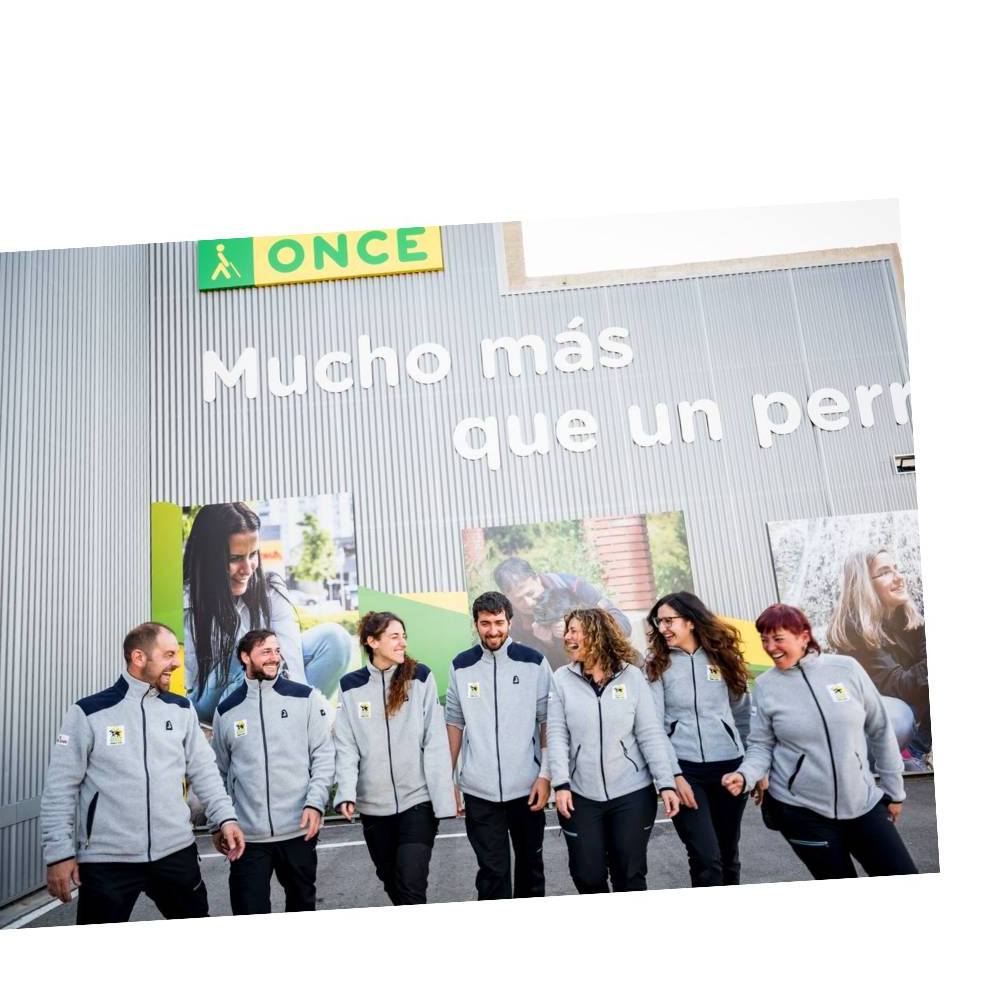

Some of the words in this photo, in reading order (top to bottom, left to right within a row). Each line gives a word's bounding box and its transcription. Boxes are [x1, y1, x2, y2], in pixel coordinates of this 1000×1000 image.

[267, 226, 428, 273] ONCE
[202, 334, 451, 403] Mucho
[480, 316, 633, 379] más
[452, 407, 598, 470] que
[628, 396, 722, 448] un
